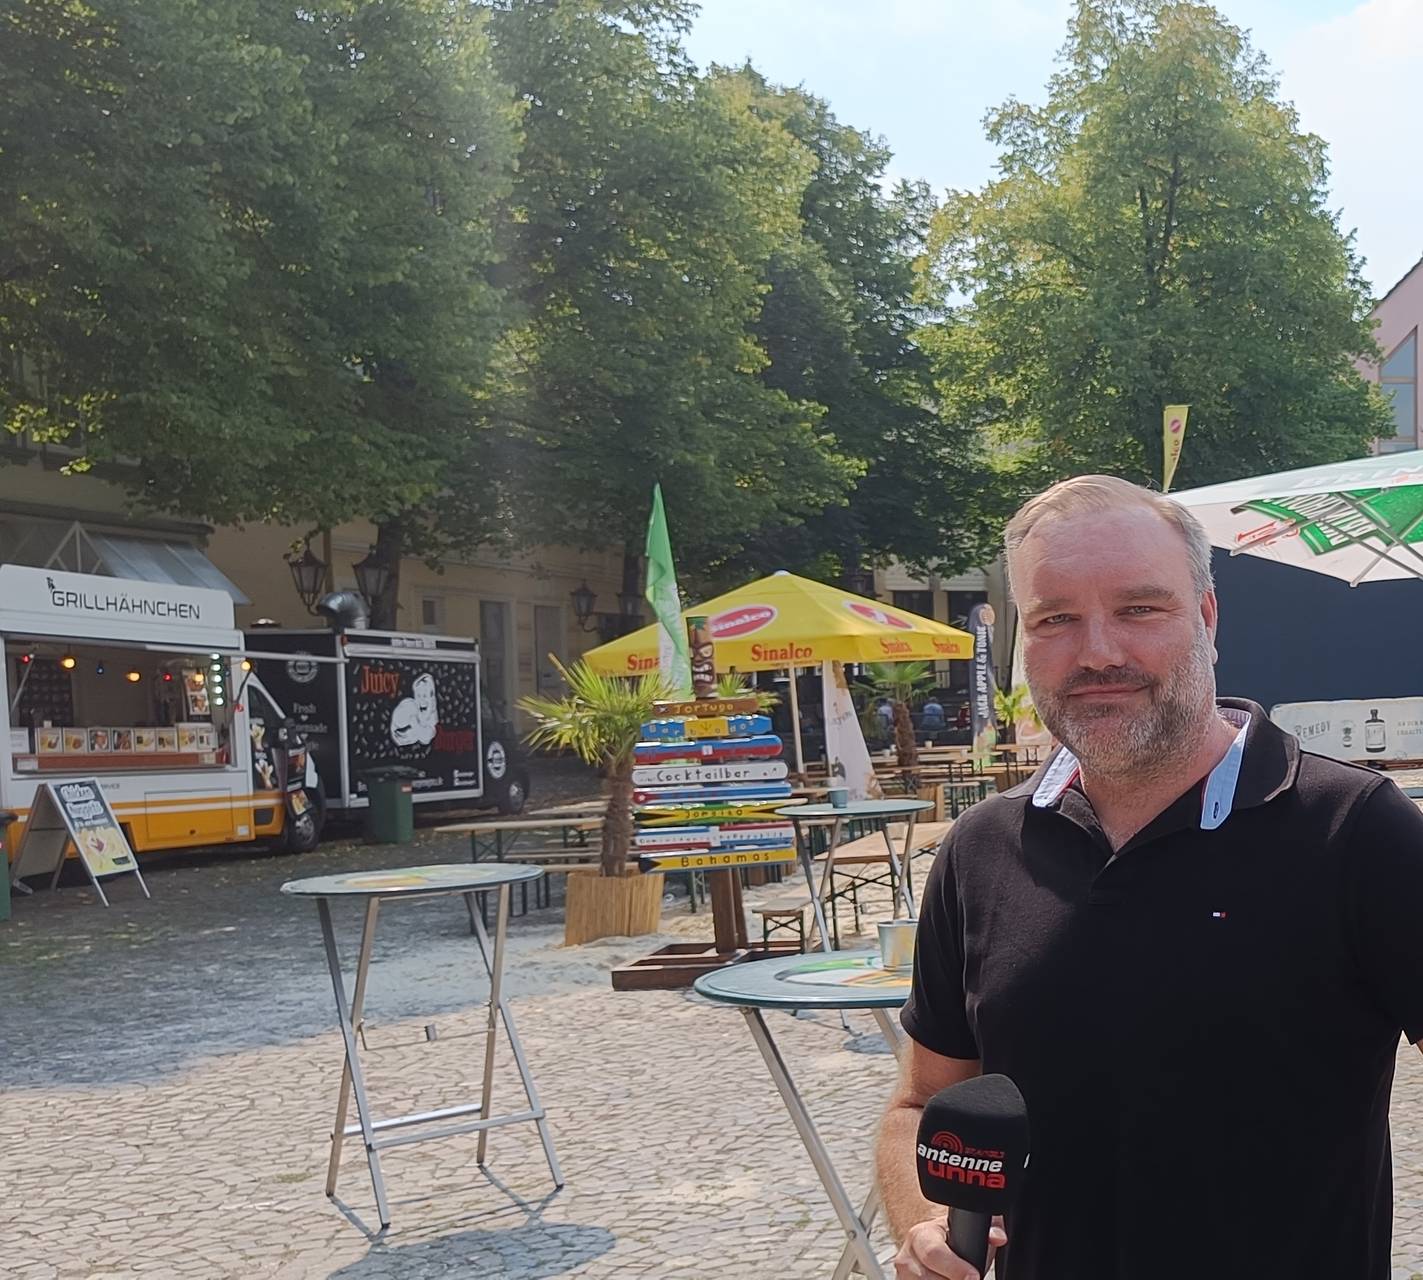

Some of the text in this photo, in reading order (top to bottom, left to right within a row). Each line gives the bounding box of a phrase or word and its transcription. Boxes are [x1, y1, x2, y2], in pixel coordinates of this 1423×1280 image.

[52, 590, 201, 620] GRILLHÄHNCHEN
[751, 642, 813, 662] Sinalco
[361, 666, 399, 697] Juicy
[656, 768, 750, 783] Cocktailbar
[681, 852, 770, 867] Bahamas
[917, 1143, 1003, 1173] antenne
[927, 1160, 1006, 1189] unna
